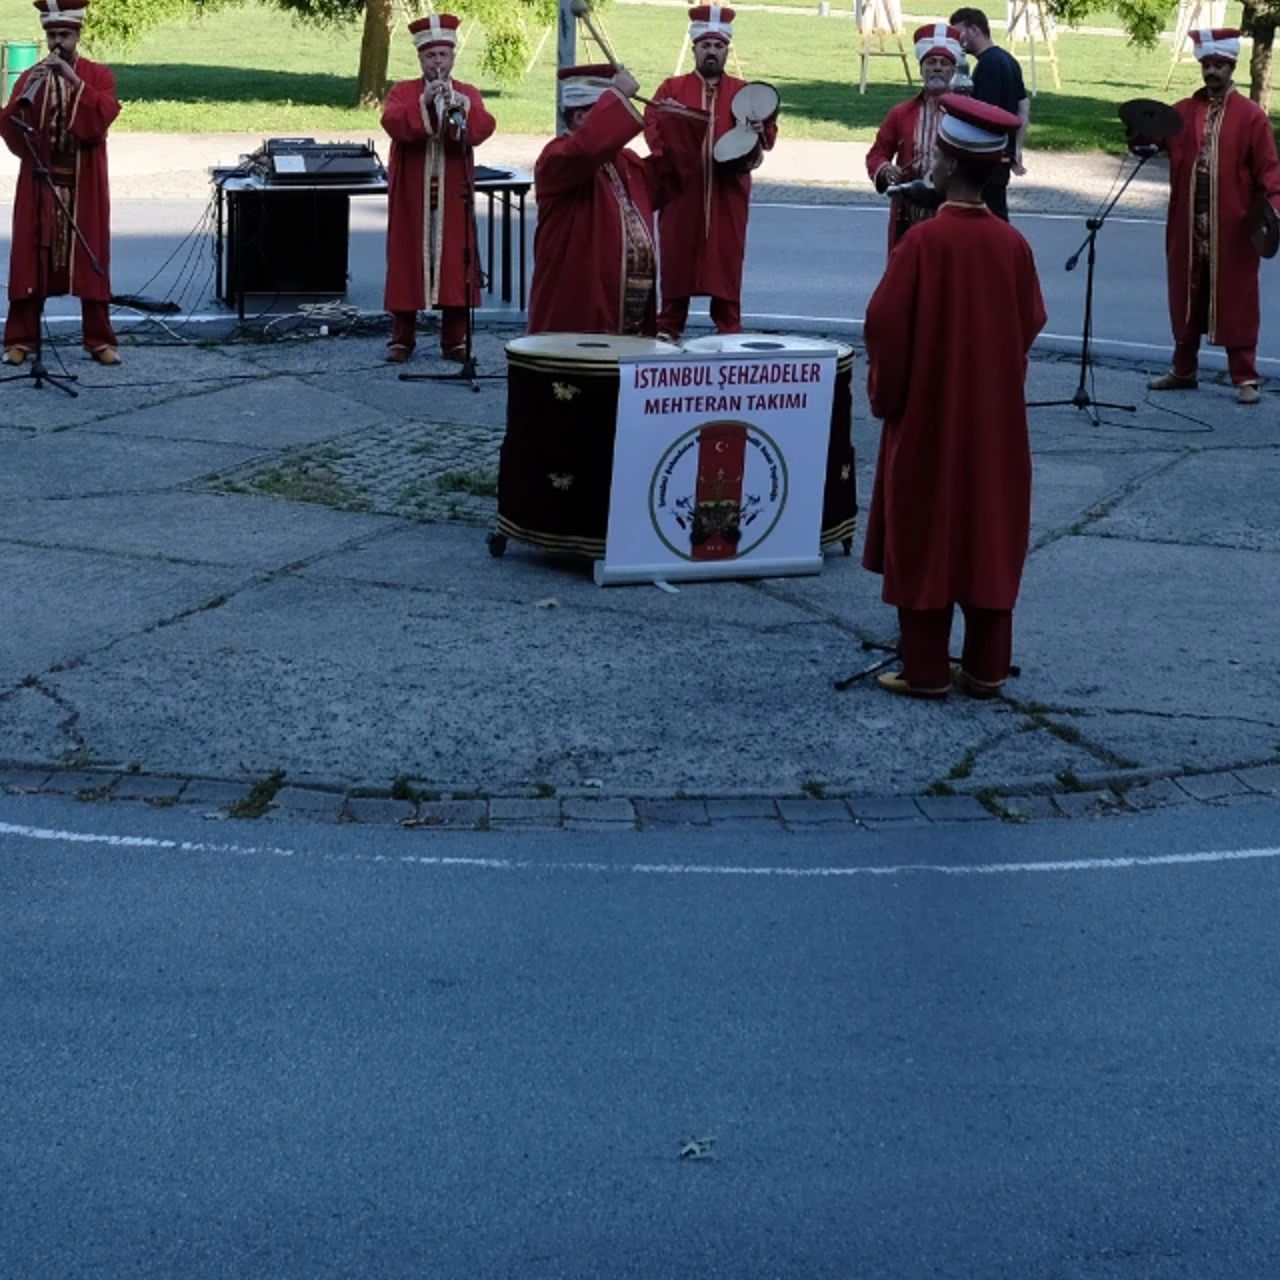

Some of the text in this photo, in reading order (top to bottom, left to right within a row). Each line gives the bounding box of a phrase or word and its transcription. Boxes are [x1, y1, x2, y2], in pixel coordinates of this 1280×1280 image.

[634, 363, 821, 390] İSTANBUL ŞEHZADELER
[643, 393, 807, 415] MEHTERAN TAKIMI
